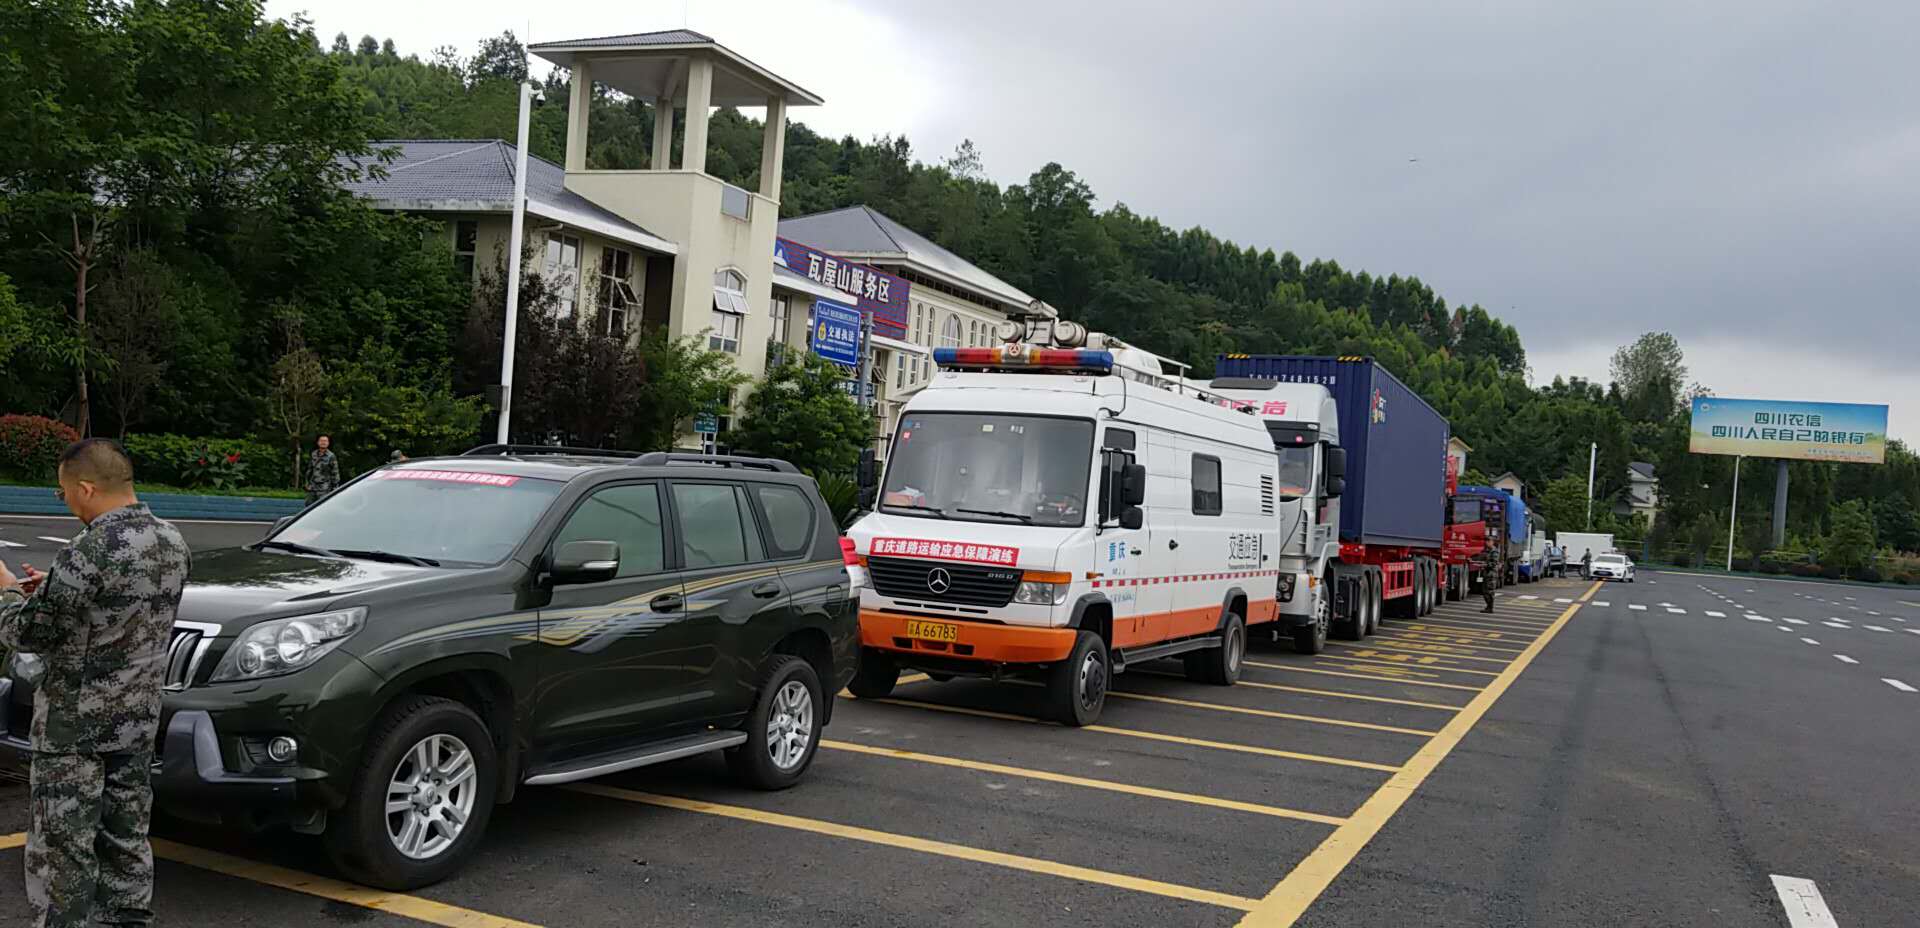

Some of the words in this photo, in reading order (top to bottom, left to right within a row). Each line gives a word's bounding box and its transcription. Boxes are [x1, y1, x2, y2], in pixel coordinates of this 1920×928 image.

[808, 253, 890, 302] 瓦屋山服务区
[828, 325, 855, 342] 交通执法
[1754, 412, 1821, 427] 四川农信
[1712, 425, 1865, 445] 四川人民自己的银行
[874, 540, 1013, 563] 重庆道路运输应急保障演练
